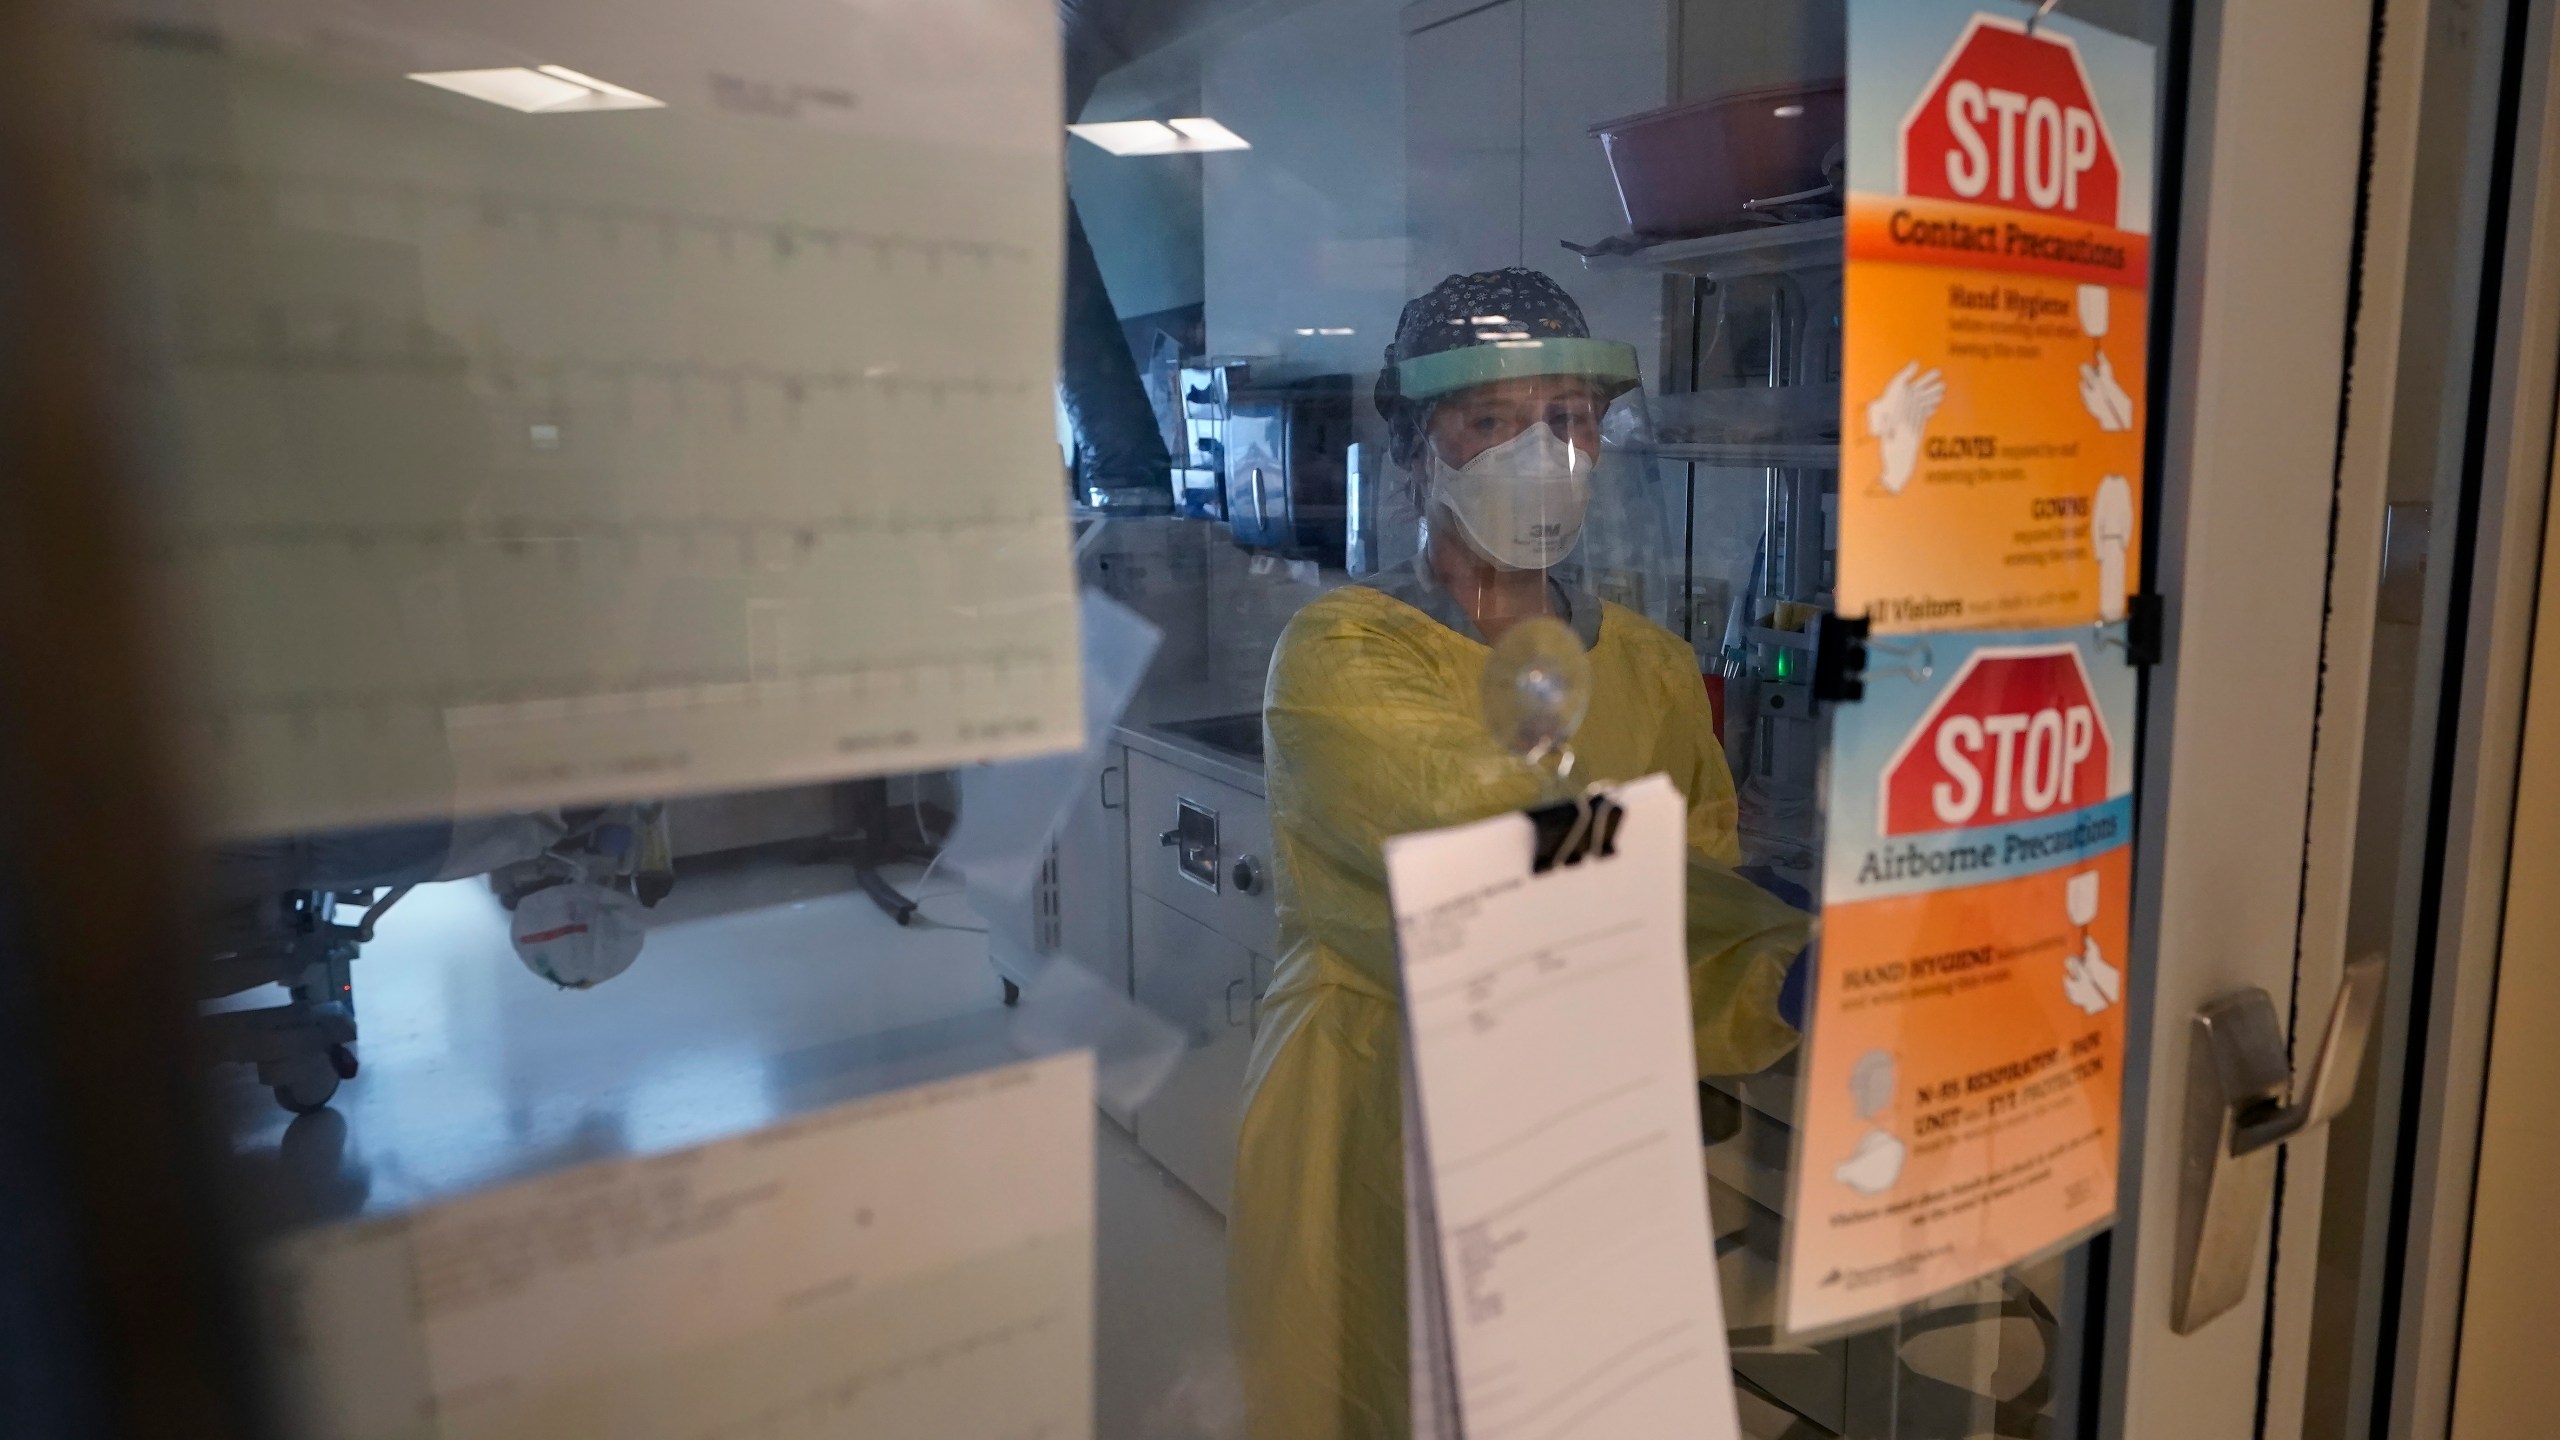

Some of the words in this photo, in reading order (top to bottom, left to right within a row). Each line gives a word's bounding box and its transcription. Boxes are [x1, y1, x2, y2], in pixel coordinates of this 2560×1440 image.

[1945, 80, 2097, 211] STOP
[1889, 209, 1998, 253] Contact
[2005, 222, 2126, 270] Precautions
[1948, 283, 1999, 310] Hand
[2003, 288, 2070, 320] Hygiene
[1926, 436, 1998, 460] GLOVES
[2031, 497, 2089, 520] GOWNS
[1530, 523, 1562, 538] 3M
[1892, 594, 1964, 621] Visitors
[1931, 704, 2093, 824] STOP
[1856, 842, 1997, 885] Airborne
[2002, 812, 2119, 866] Precautions
[1841, 960, 1907, 990] HAND
[1909, 944, 1993, 979] HYGIENE
[1912, 1106, 1963, 1137] UNIT
